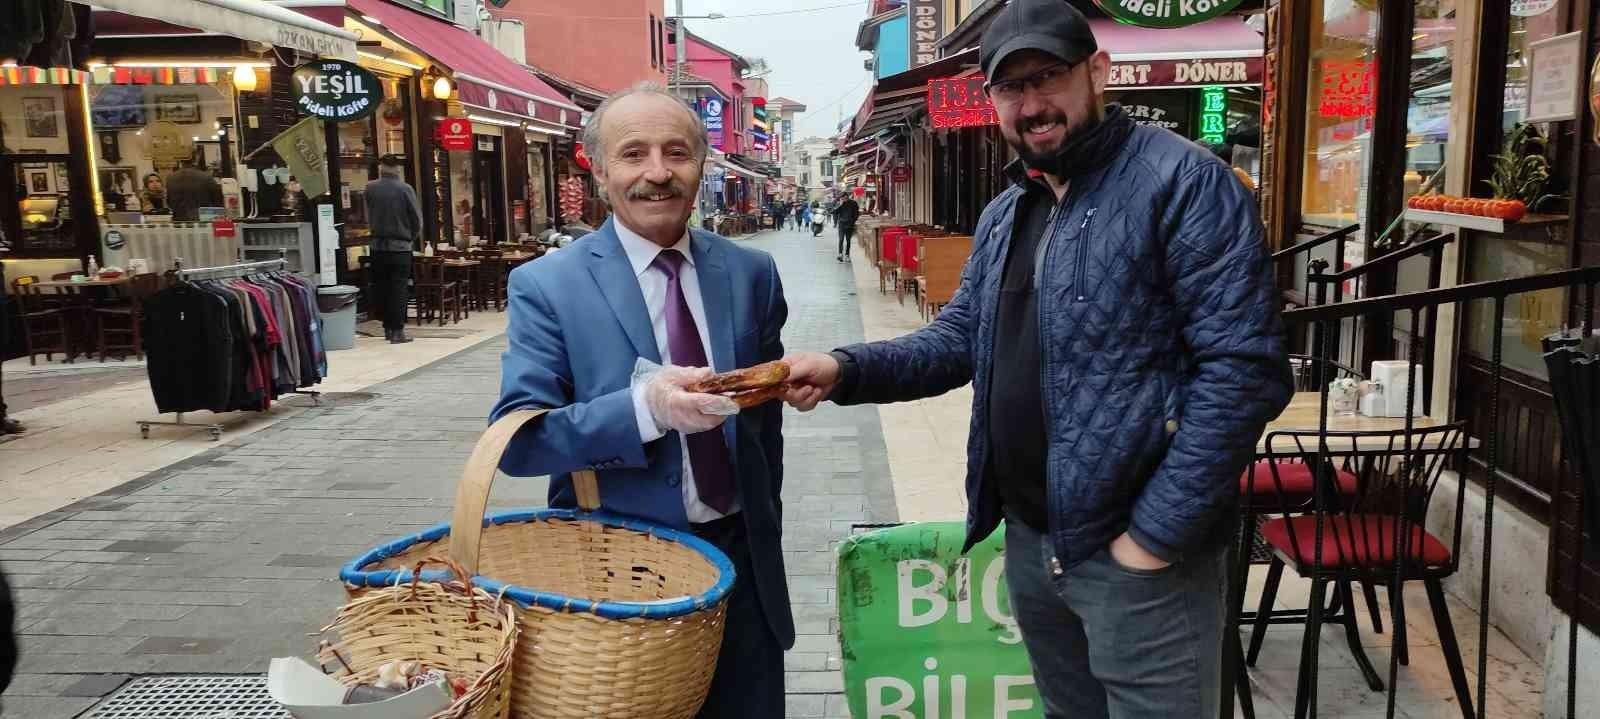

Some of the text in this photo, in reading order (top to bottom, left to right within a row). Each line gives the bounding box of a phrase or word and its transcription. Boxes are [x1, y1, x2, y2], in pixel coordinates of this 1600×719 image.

[322, 63, 342, 71] 1970
[1107, 59, 1248, 84] ERT DÖNER
[297, 70, 369, 100] YEŞİL
[299, 95, 369, 117] Pideli Köfte
[898, 556, 1024, 645] BIÇ
